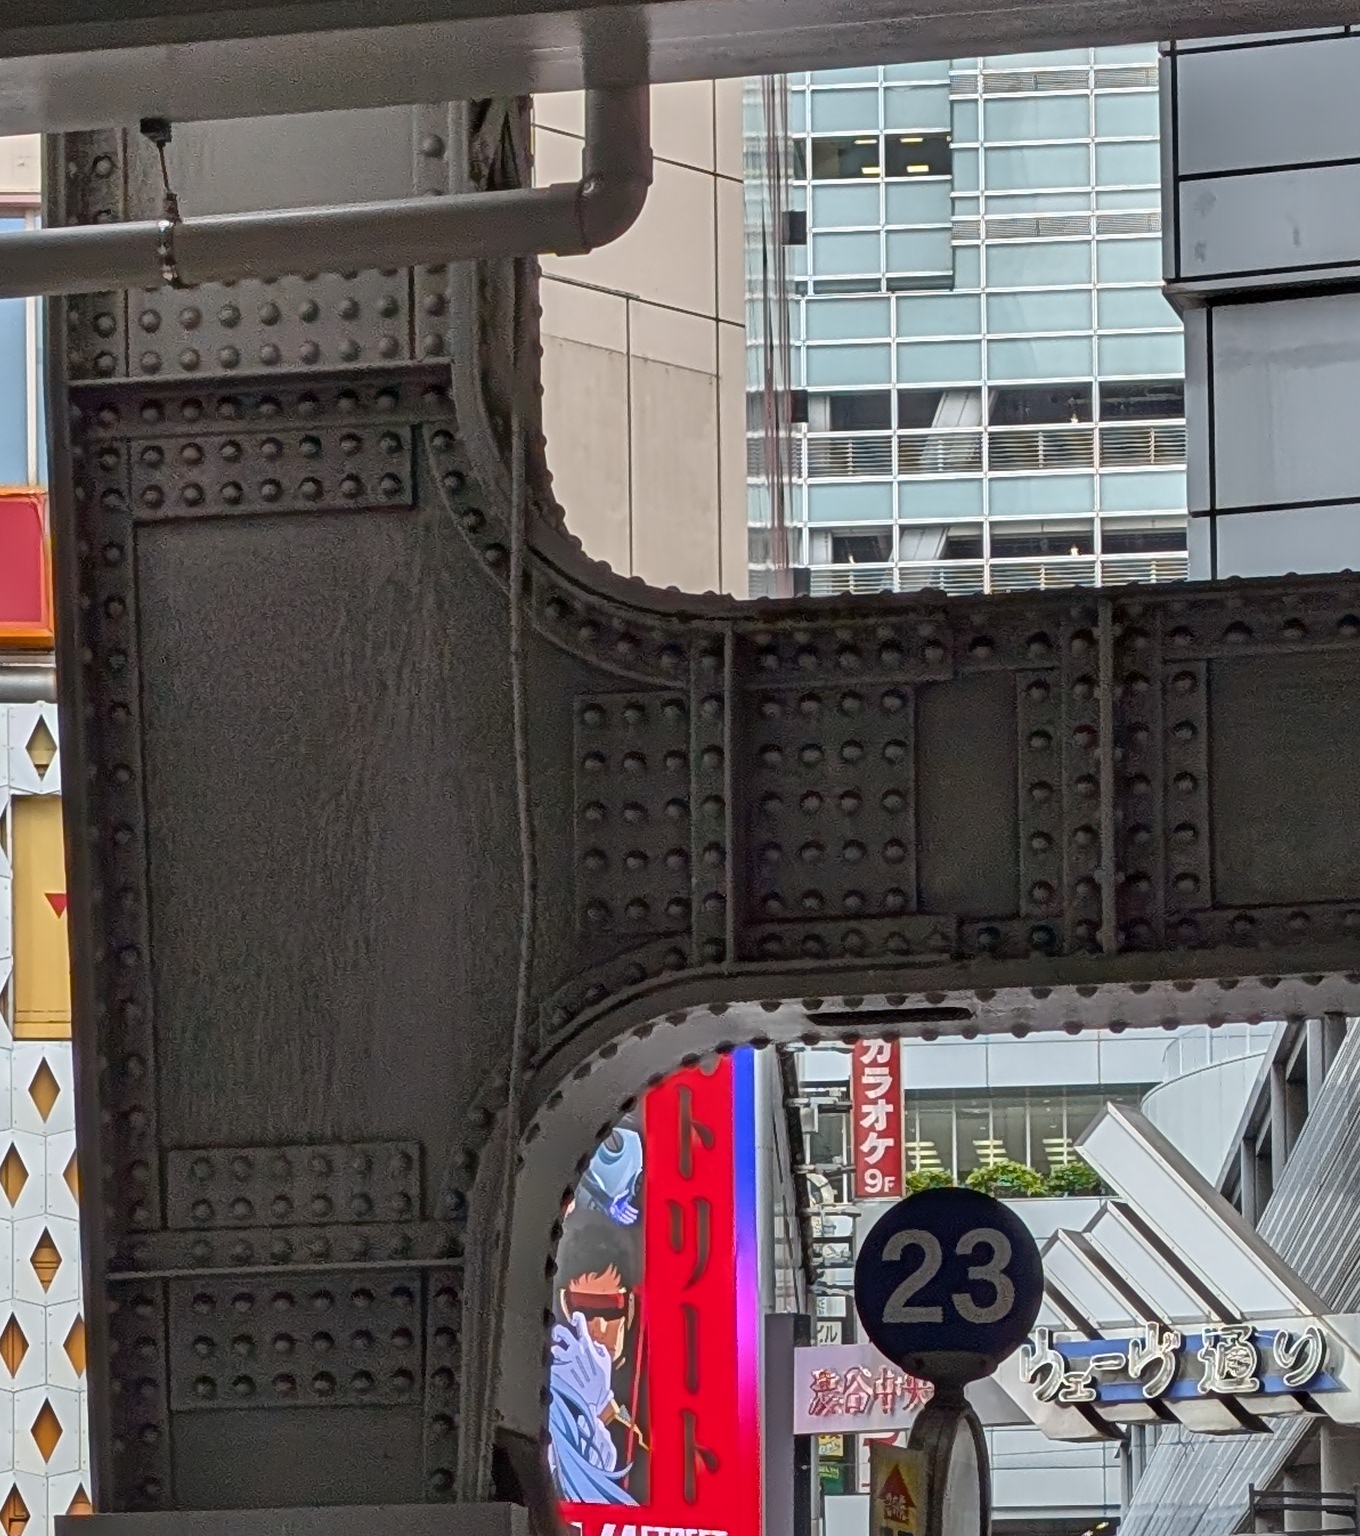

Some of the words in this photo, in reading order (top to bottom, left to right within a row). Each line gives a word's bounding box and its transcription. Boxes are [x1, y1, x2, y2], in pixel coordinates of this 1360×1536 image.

[859, 1038, 895, 1165] カラオケ
[864, 1168, 896, 1194] 9F
[673, 1058, 722, 1506] トリート
[881, 1227, 1016, 1325] 23
